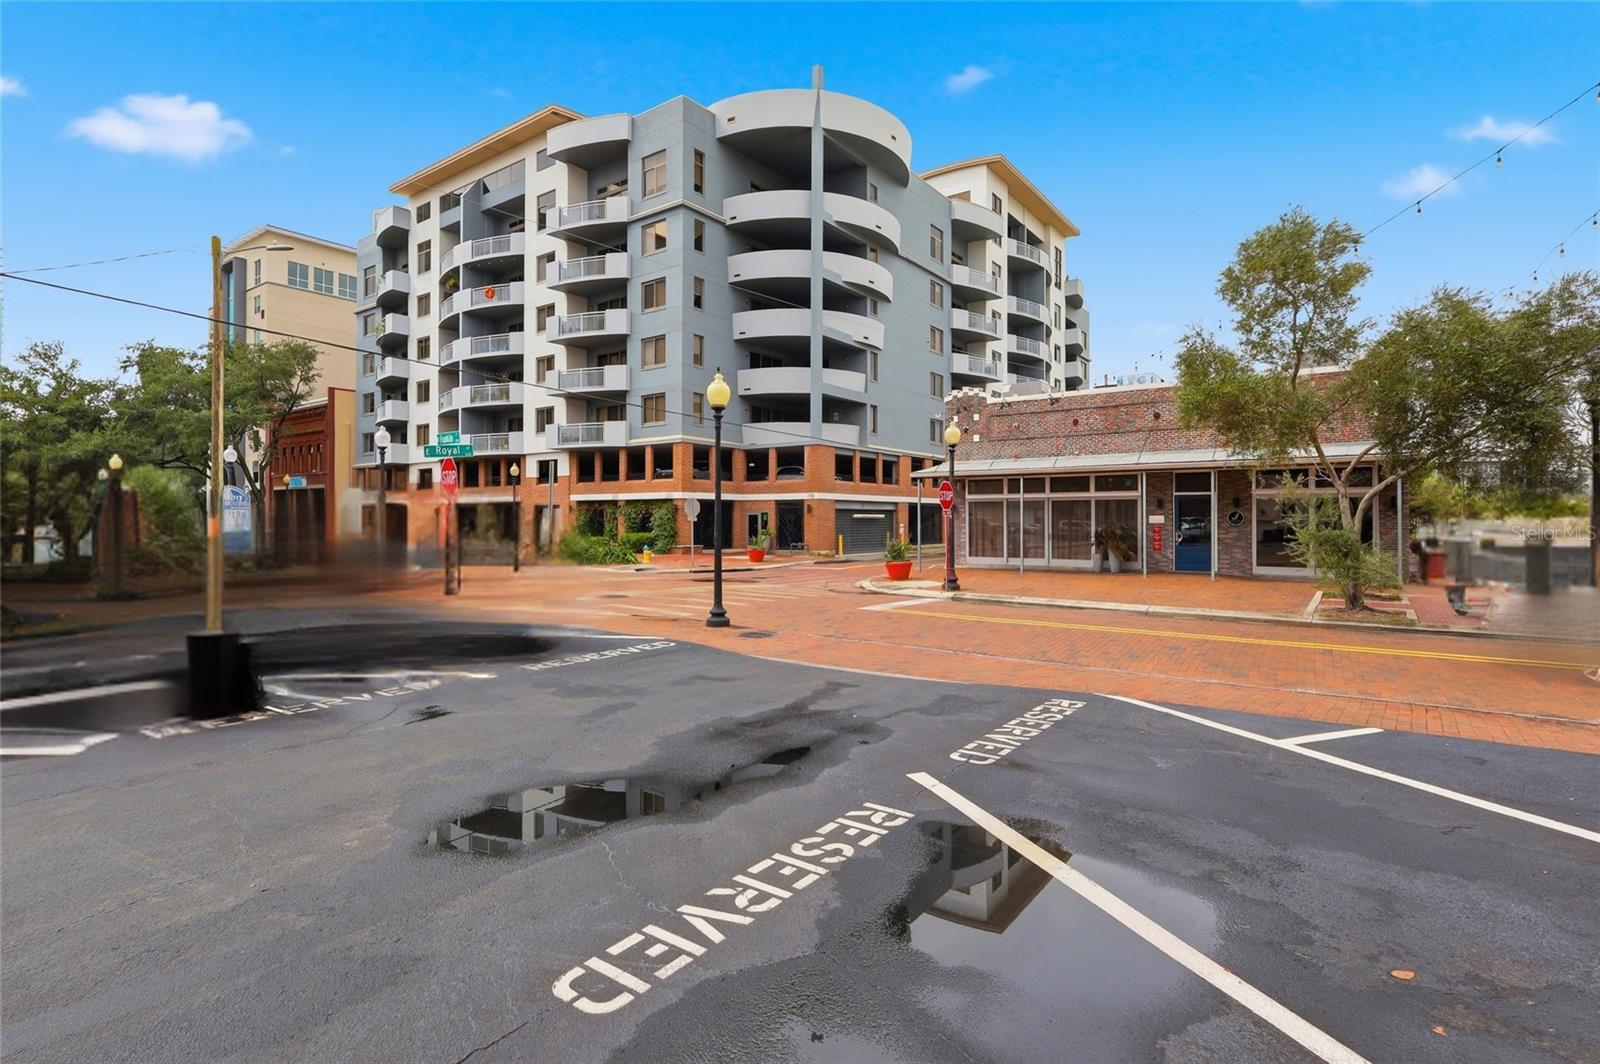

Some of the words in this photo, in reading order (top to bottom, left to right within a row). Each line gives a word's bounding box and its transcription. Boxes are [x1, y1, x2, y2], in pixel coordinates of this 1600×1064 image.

[435, 446, 460, 456] Royal
[442, 470, 456, 485] STOP
[940, 490, 953, 501] STOP
[949, 698, 1088, 765] RESERVED
[551, 801, 916, 1015] RESERVED
